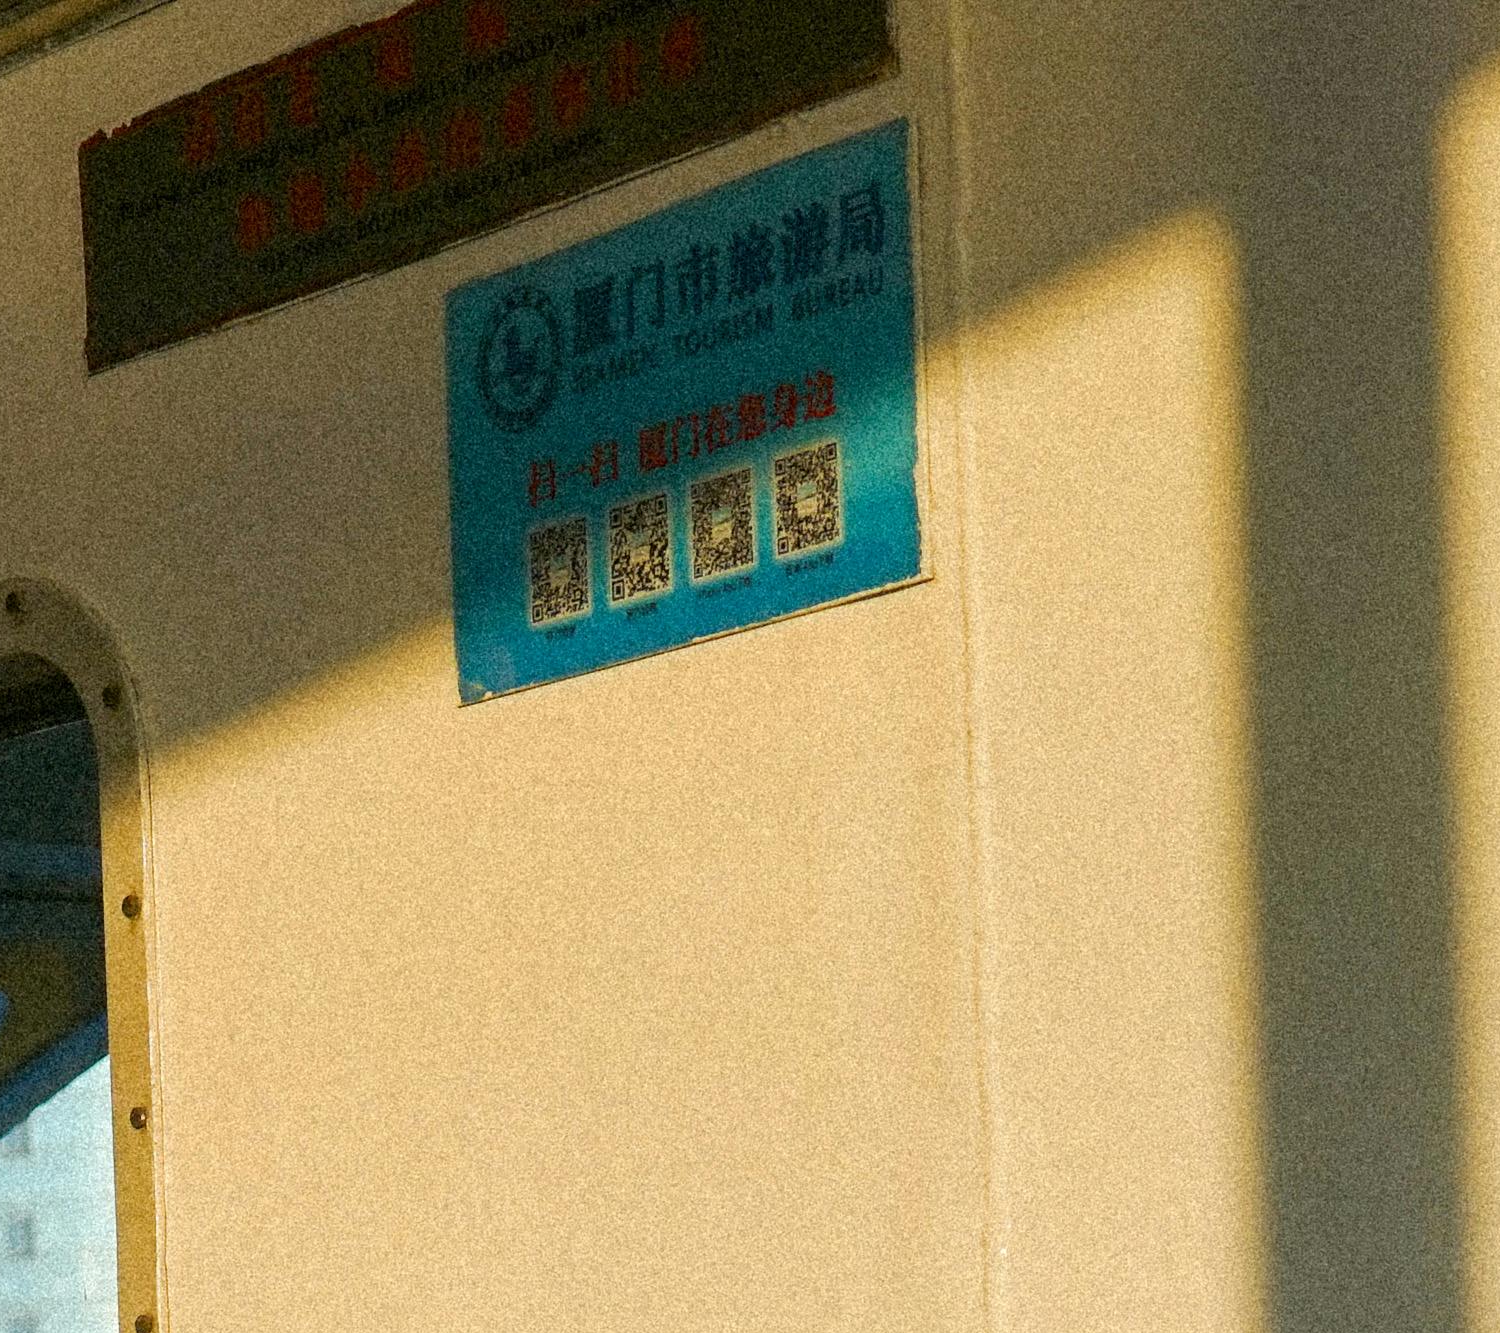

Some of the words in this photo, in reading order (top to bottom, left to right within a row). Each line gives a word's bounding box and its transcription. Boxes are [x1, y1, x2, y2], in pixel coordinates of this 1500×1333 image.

[573, 180, 887, 355] 厦门市旅游局
[673, 302, 774, 357] TOURISM
[791, 264, 885, 321] BUREAU
